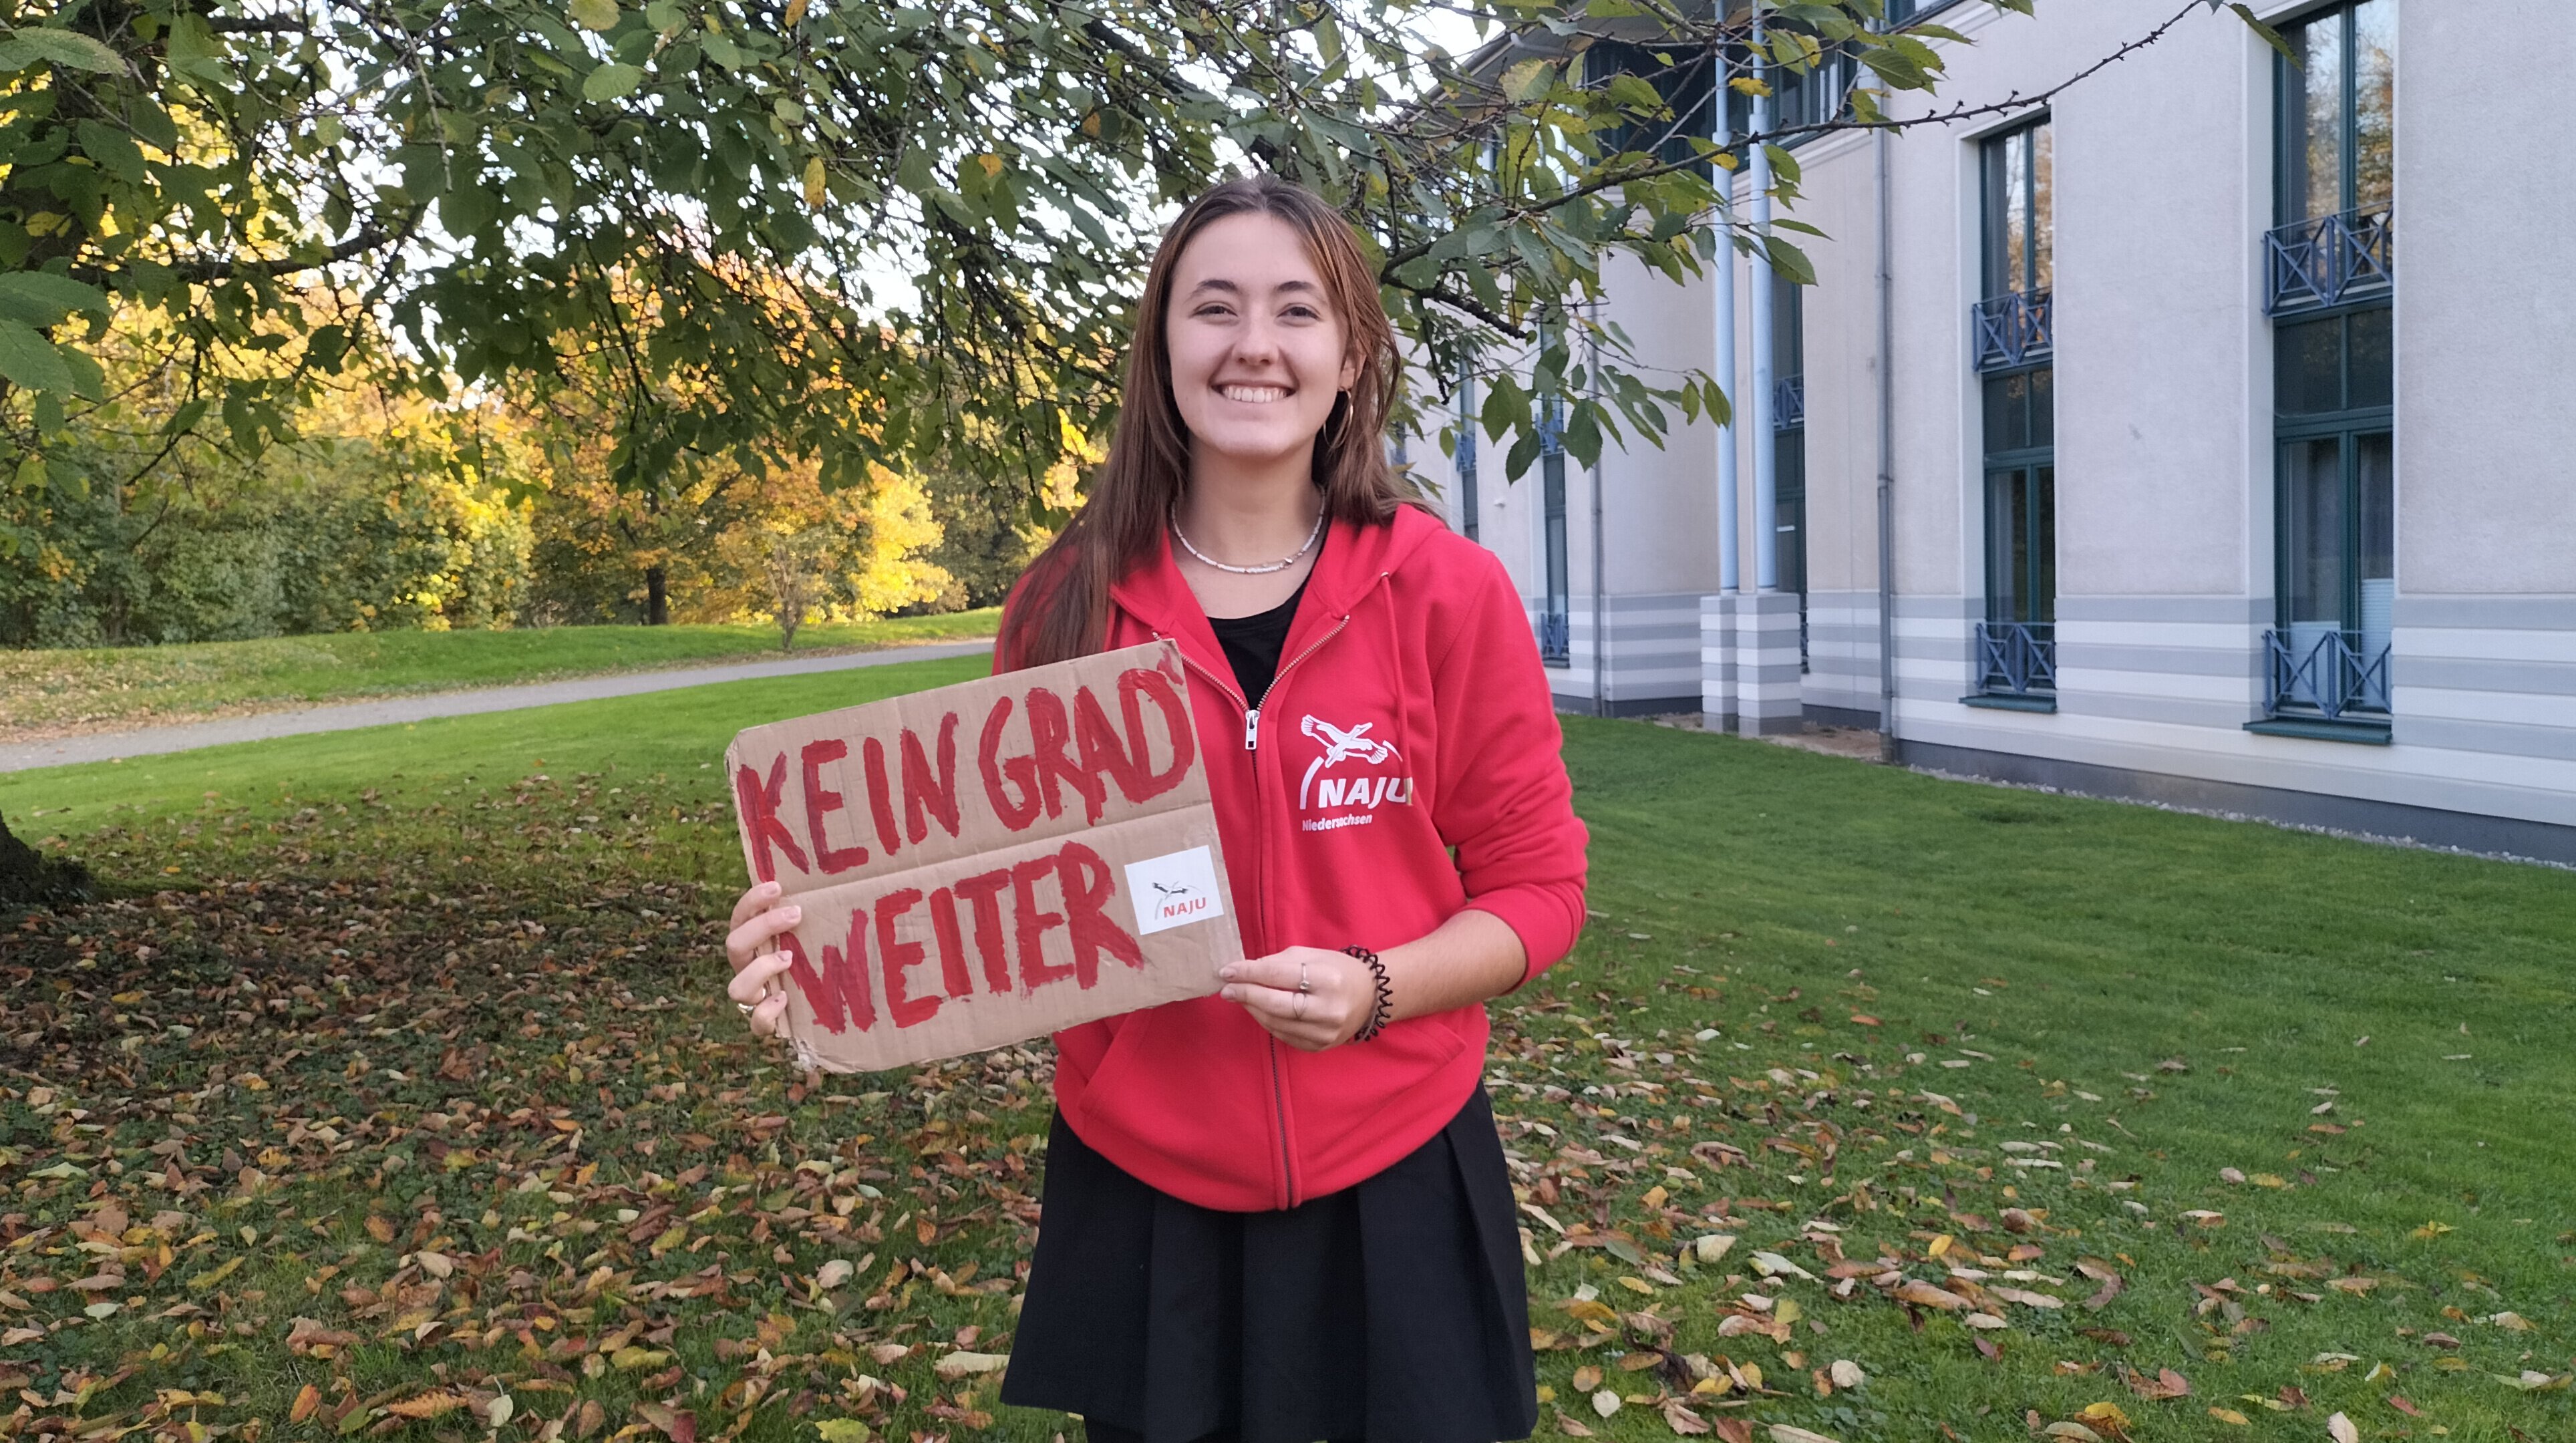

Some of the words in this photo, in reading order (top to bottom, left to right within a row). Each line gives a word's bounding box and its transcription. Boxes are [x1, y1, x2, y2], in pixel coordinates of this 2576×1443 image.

[736, 711, 959, 881] KEIN
[977, 669, 1194, 831] GRAD
[1318, 777, 1414, 809] NAJU
[779, 840, 1144, 1034] WEITER
[1163, 897, 1206, 918] NAJU
